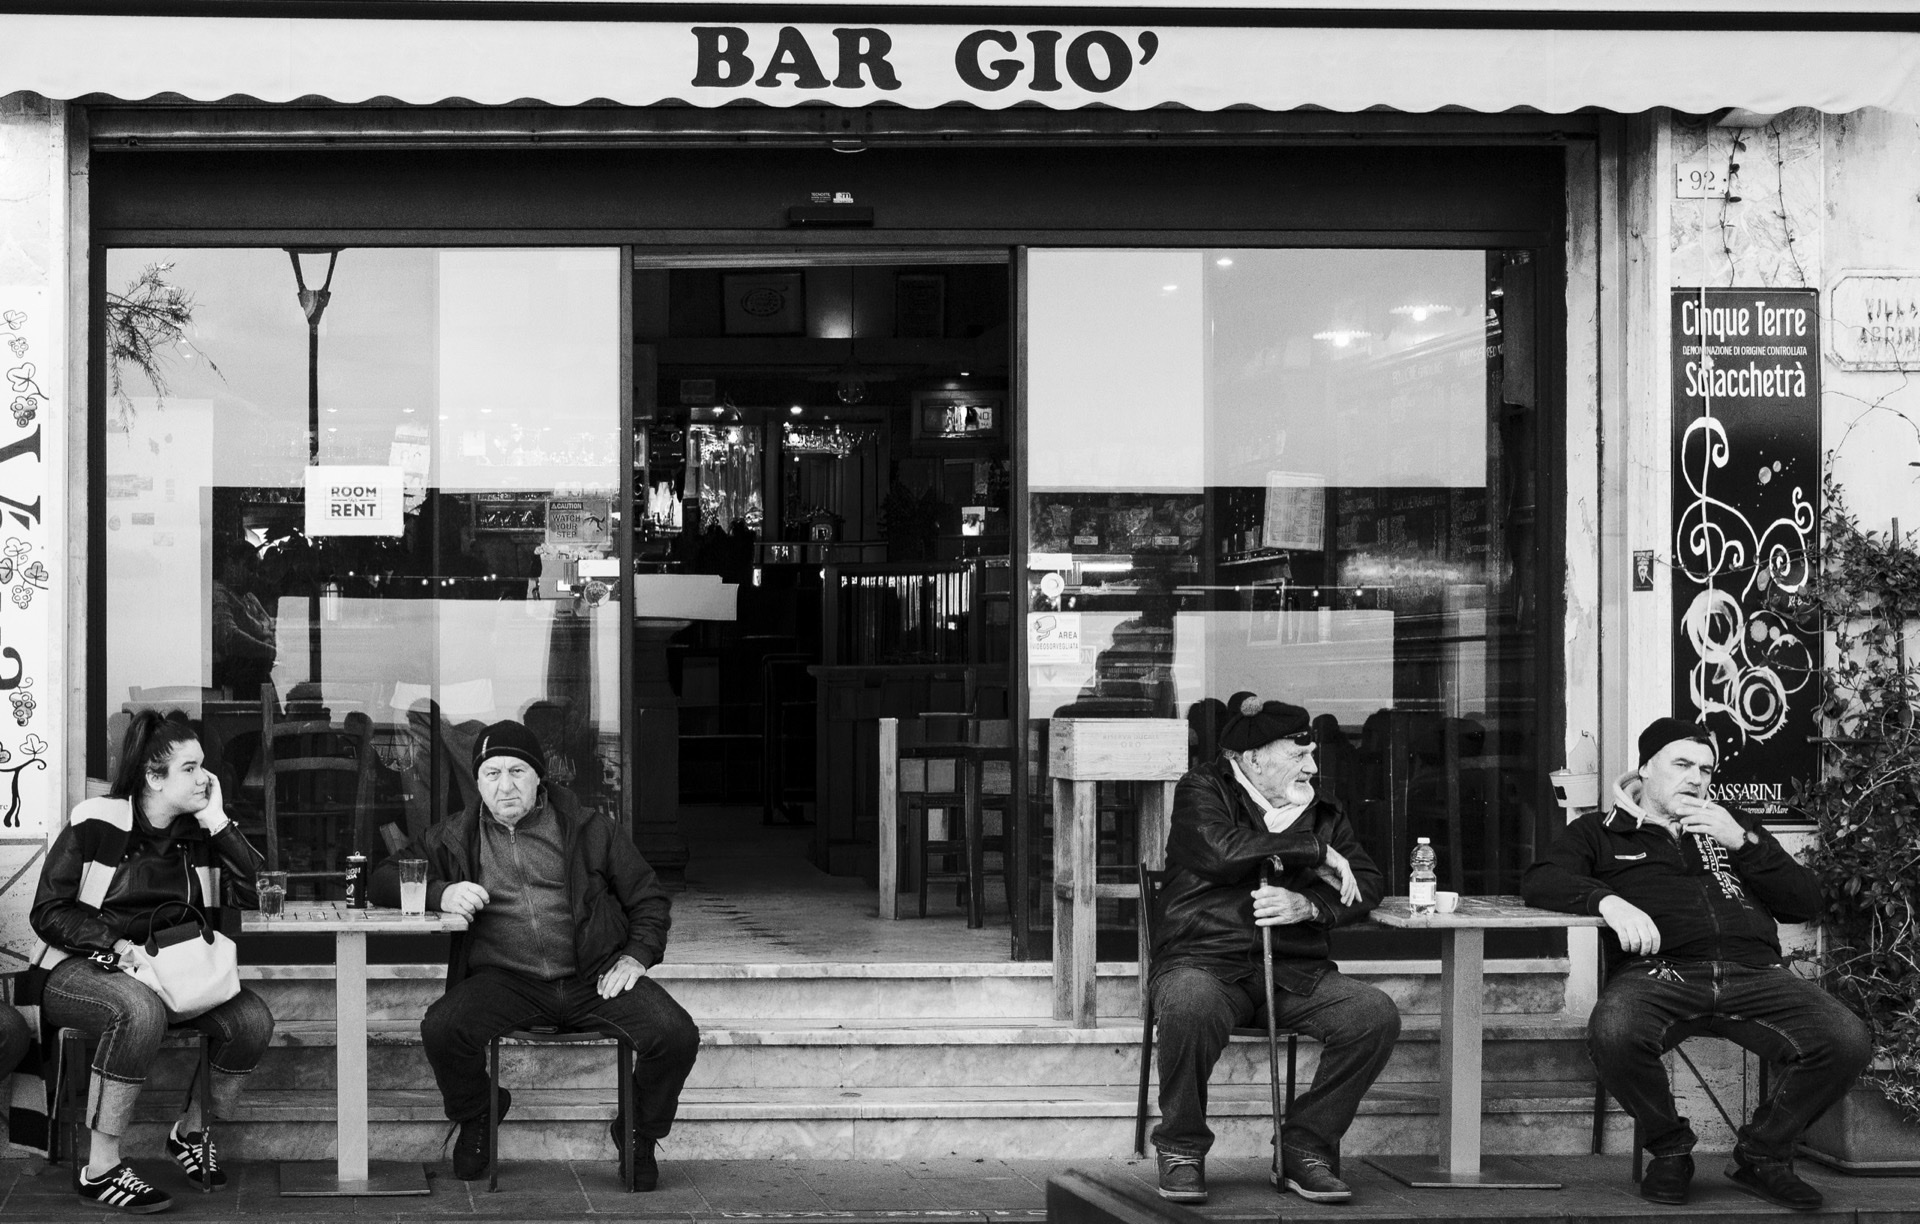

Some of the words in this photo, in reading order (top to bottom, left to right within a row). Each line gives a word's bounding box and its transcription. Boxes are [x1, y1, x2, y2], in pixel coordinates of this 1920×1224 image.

[691, 26, 902, 90] BAR
[955, 29, 1159, 93] GIO'
[1690, 170, 1715, 190] 92
[1681, 300, 1750, 342] Cinque
[1755, 301, 1806, 336] Terre
[1733, 345, 1740, 355] DI
[1741, 345, 1766, 355] ORIGINE
[1766, 345, 1808, 355] CONTROLLATA
[1685, 361, 1806, 397] Sciacchetrà
[331, 486, 377, 497] ROOM
[331, 503, 377, 517] RENT
[552, 514, 581, 522] WATCH
[555, 522, 578, 530] YOUR
[1058, 631, 1078, 639] AREA
[1031, 642, 1079, 650] VIDEOSORVEGLIATA
[1708, 783, 1783, 801] SASSARINI
